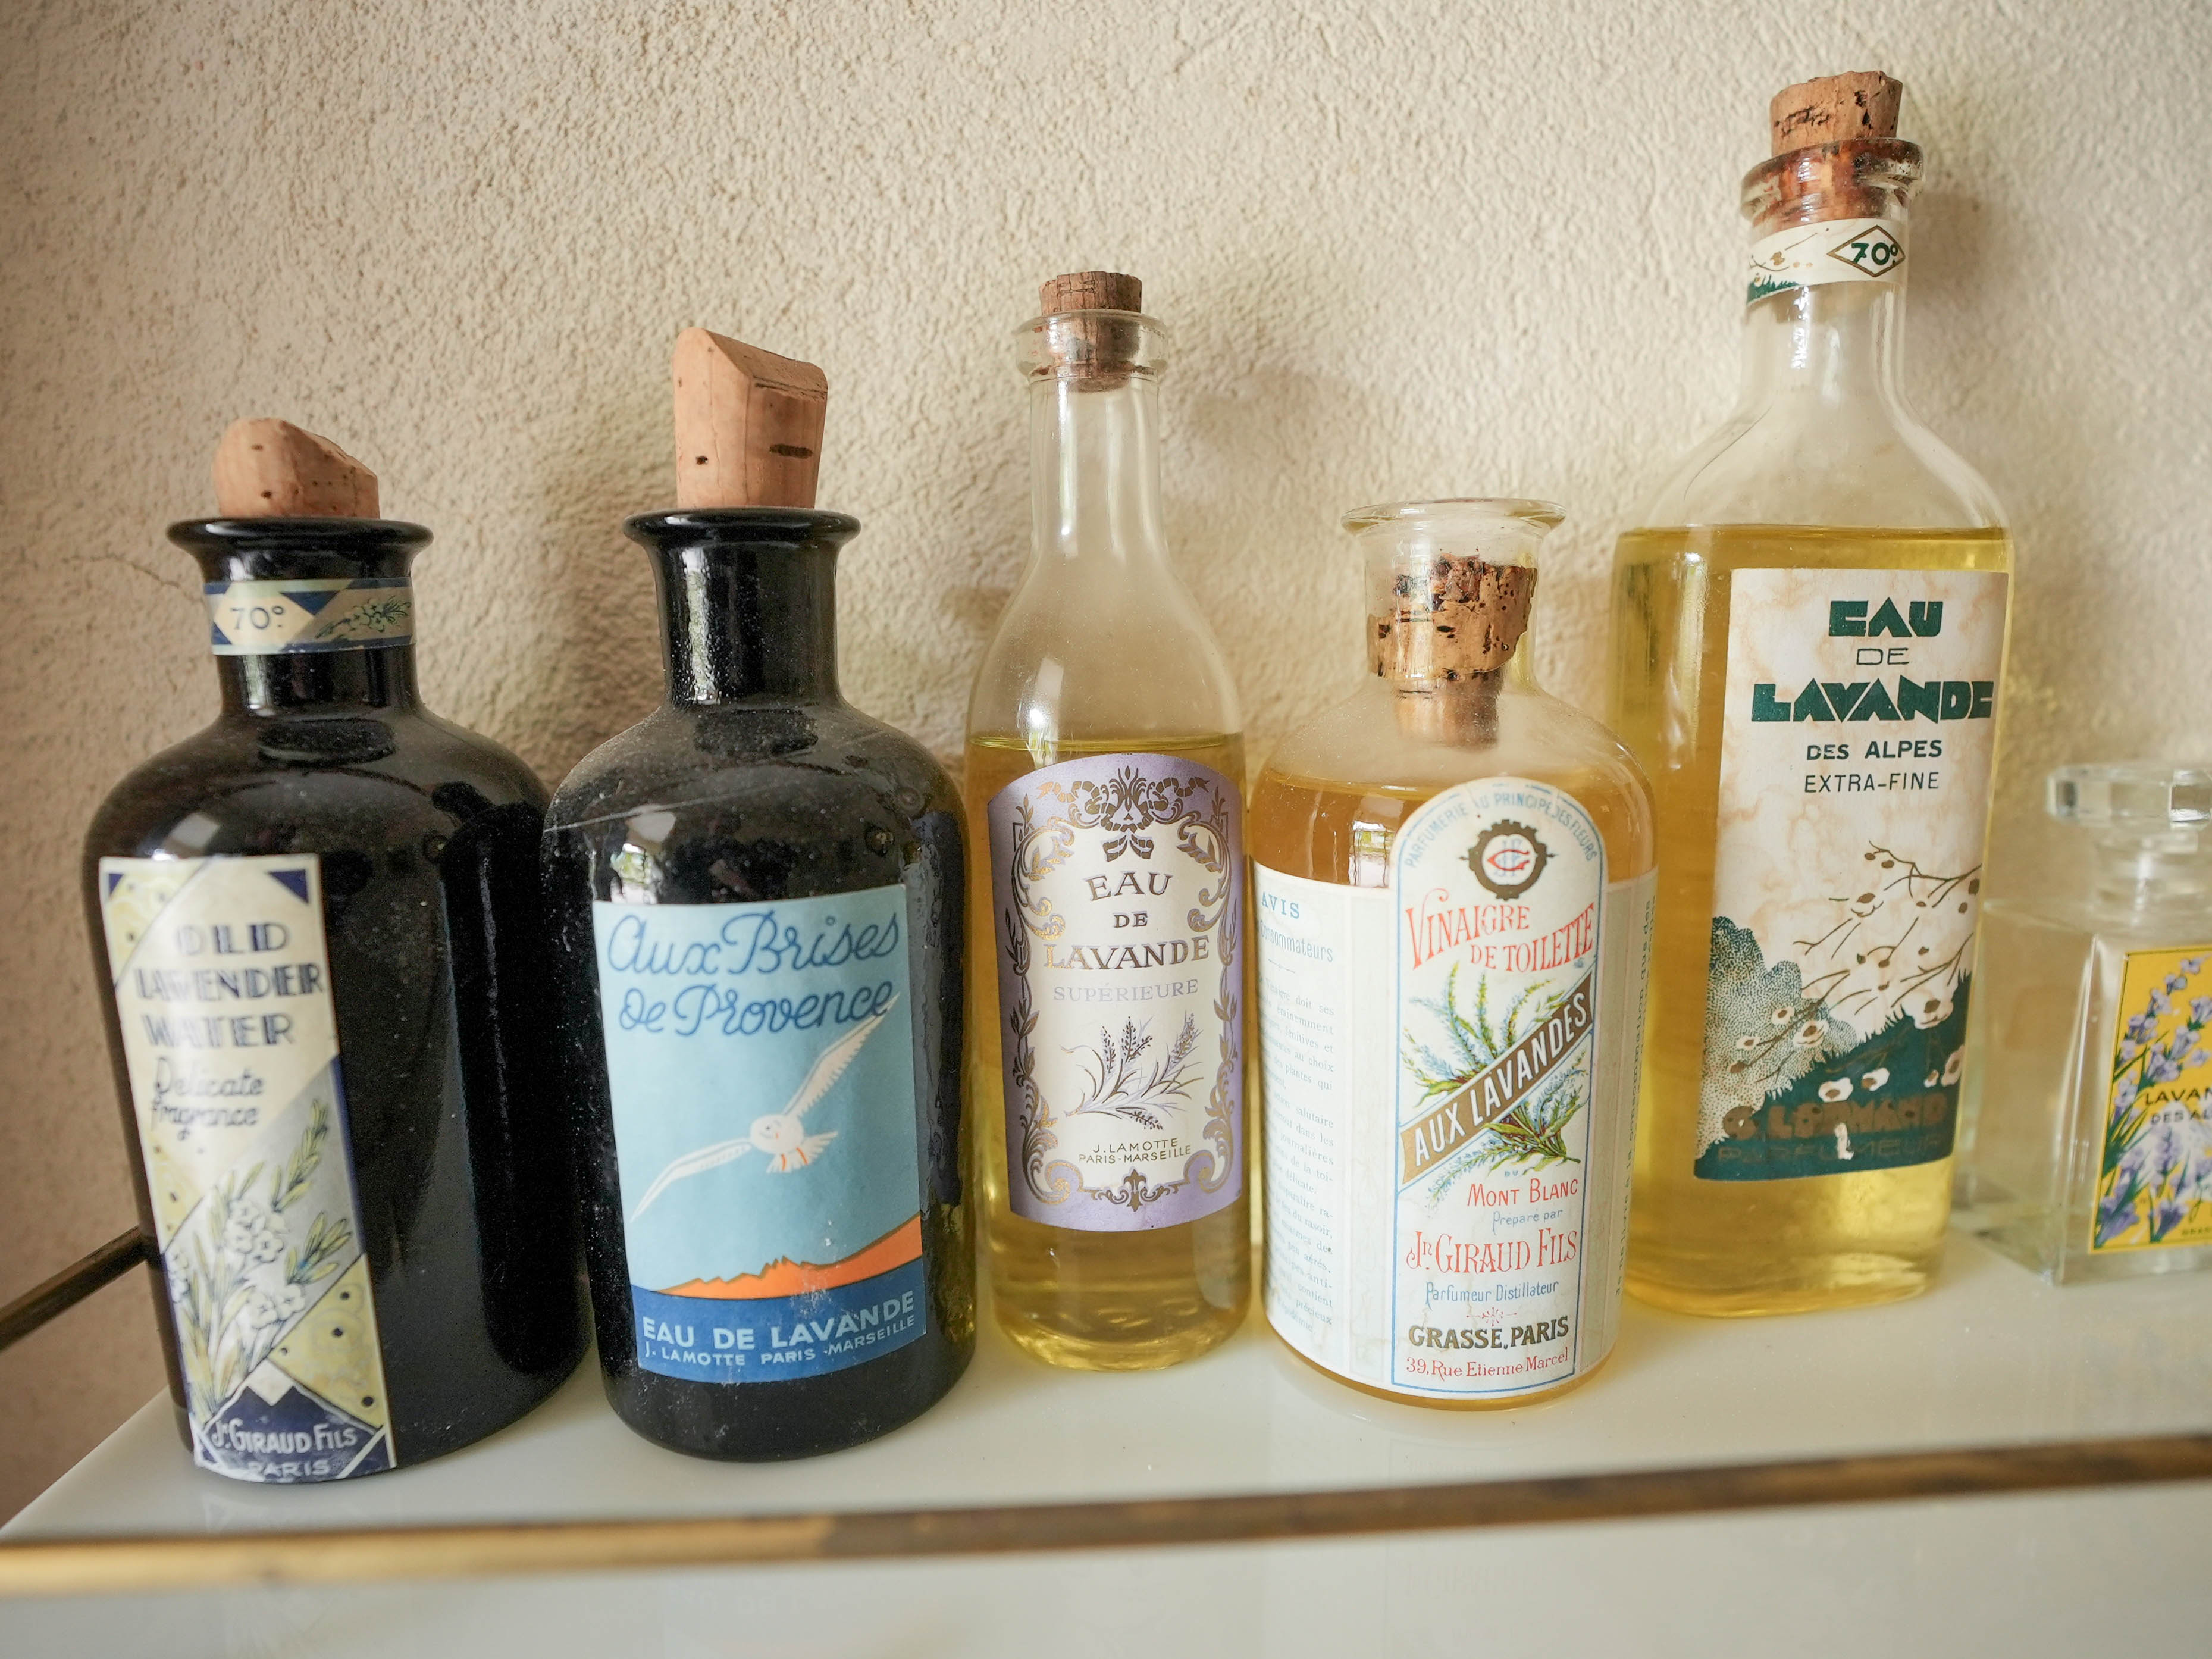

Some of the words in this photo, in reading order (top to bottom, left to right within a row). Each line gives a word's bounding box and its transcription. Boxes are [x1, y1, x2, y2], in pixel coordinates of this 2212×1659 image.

[1828, 597, 1943, 637] EAU
[1856, 647, 1910, 665] DE
[1751, 675, 1994, 724] LAVANDE
[1806, 744, 1849, 760] DES
[1865, 740, 1942, 759] ALPES
[1804, 772, 1939, 793] EXTRA-FINE
[1405, 803, 1468, 868] PARFUMERIE
[1572, 821, 1598, 862] FLEURS
[1086, 871, 1173, 901] EAU
[1114, 912, 1148, 928] DE
[1261, 891, 1300, 919] AVIS
[178, 923, 290, 956] OLD
[609, 915, 722, 975] Aux
[722, 910, 900, 974] Brises
[1405, 888, 1530, 970] VINAIGRE
[1471, 944, 1497, 969] DE
[1503, 902, 1594, 972] TOILETTE
[1043, 935, 1210, 969] LAVANDE
[134, 962, 324, 1002] LAVENDER
[1053, 979, 1198, 1003] SUPÉRIEURE
[675, 981, 894, 1035] Provence
[1318, 1004, 1334, 1016] ses
[142, 1012, 296, 1049] WATER
[1308, 1056, 1334, 1073] choix
[1414, 1103, 1466, 1167] AUX
[1470, 993, 1587, 1126] LAVANDES
[1317, 1079, 1333, 1091] qui
[1295, 1106, 1334, 1129] salutaire
[1320, 1133, 1334, 1147] les
[1467, 1183, 1521, 1207] MONT
[1529, 1178, 1578, 1204] BLANC
[1543, 1209, 1564, 1223] par
[1435, 1233, 1531, 1275] GIRAUD
[1537, 1227, 1578, 1268] FILS
[1425, 1281, 1492, 1311] Parfumeur
[1496, 1279, 1559, 1302] Distillateur
[642, 1316, 695, 1348] EAU
[713, 1328, 755, 1350] DE
[771, 1290, 914, 1349] LAVANDE
[644, 1341, 656, 1357] J.
[662, 1346, 746, 1367] LAMOTTE
[760, 1348, 816, 1366] PARIS
[1431, 1360, 1463, 1382] Rue
[1466, 1361, 1524, 1377] Etienne
[1526, 1347, 1569, 1372] Marcel
[228, 1417, 312, 1454] GIRAUD
[313, 1423, 358, 1451] FILS
[247, 1459, 330, 1478] PARIS
